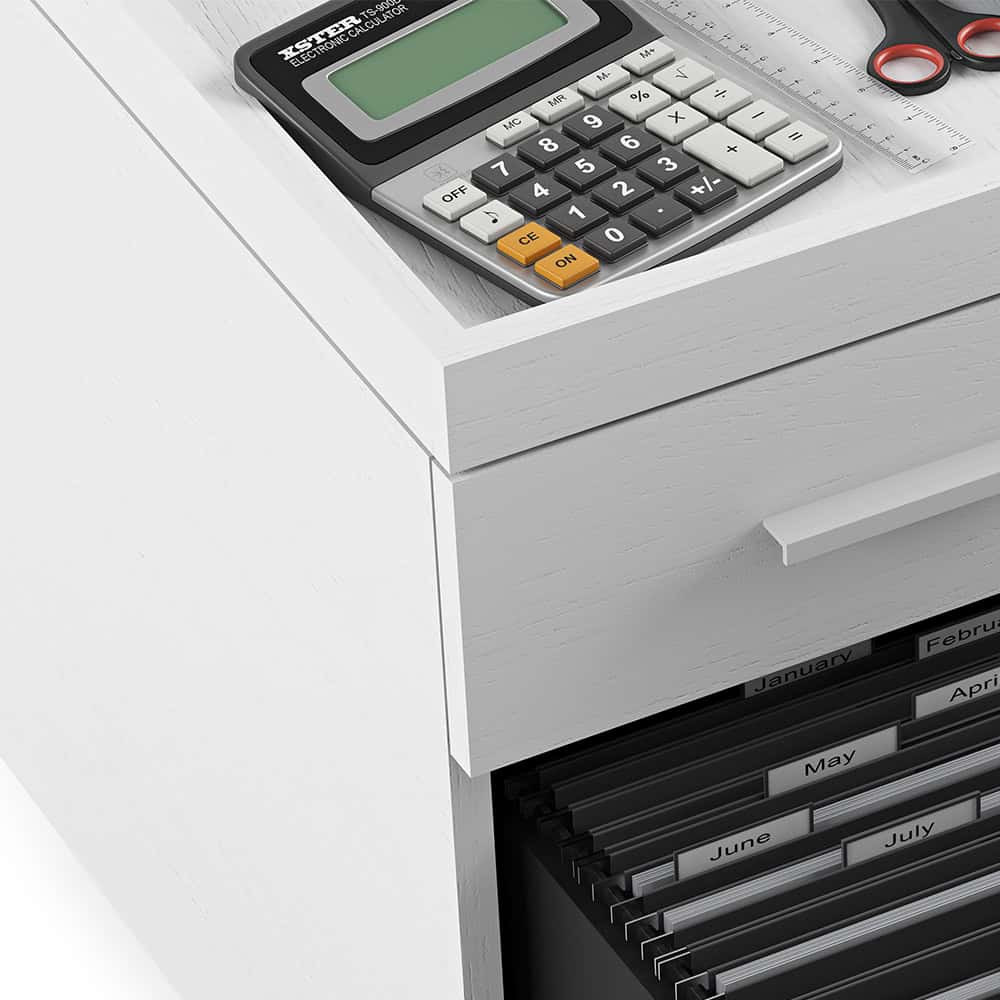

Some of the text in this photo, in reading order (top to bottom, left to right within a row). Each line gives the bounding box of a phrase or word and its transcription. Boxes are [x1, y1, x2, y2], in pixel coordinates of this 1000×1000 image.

[289, 4, 408, 67] ELECTRONIC CALCULATOR
[639, 48, 655, 59] M+
[596, 71, 611, 81] M-
[547, 93, 567, 107] MR
[630, 90, 650, 102] %
[502, 118, 522, 131] MC
[583, 114, 603, 128] 9
[538, 137, 559, 152] 8
[620, 135, 640, 149] 6
[490, 160, 509, 177] 7
[574, 158, 595, 173] 5
[657, 156, 678, 171] 3
[533, 182, 550, 197] 4
[612, 180, 635, 197] 2
[690, 175, 721, 195] +/-
[441, 185, 469, 203] OFF
[568, 204, 587, 219] 1
[518, 231, 540, 246] CE
[604, 227, 625, 242] 0
[555, 253, 577, 268] ON
[753, 649, 853, 692] January
[803, 749, 856, 777] May
[884, 821, 936, 849] July
[709, 831, 772, 862] June
